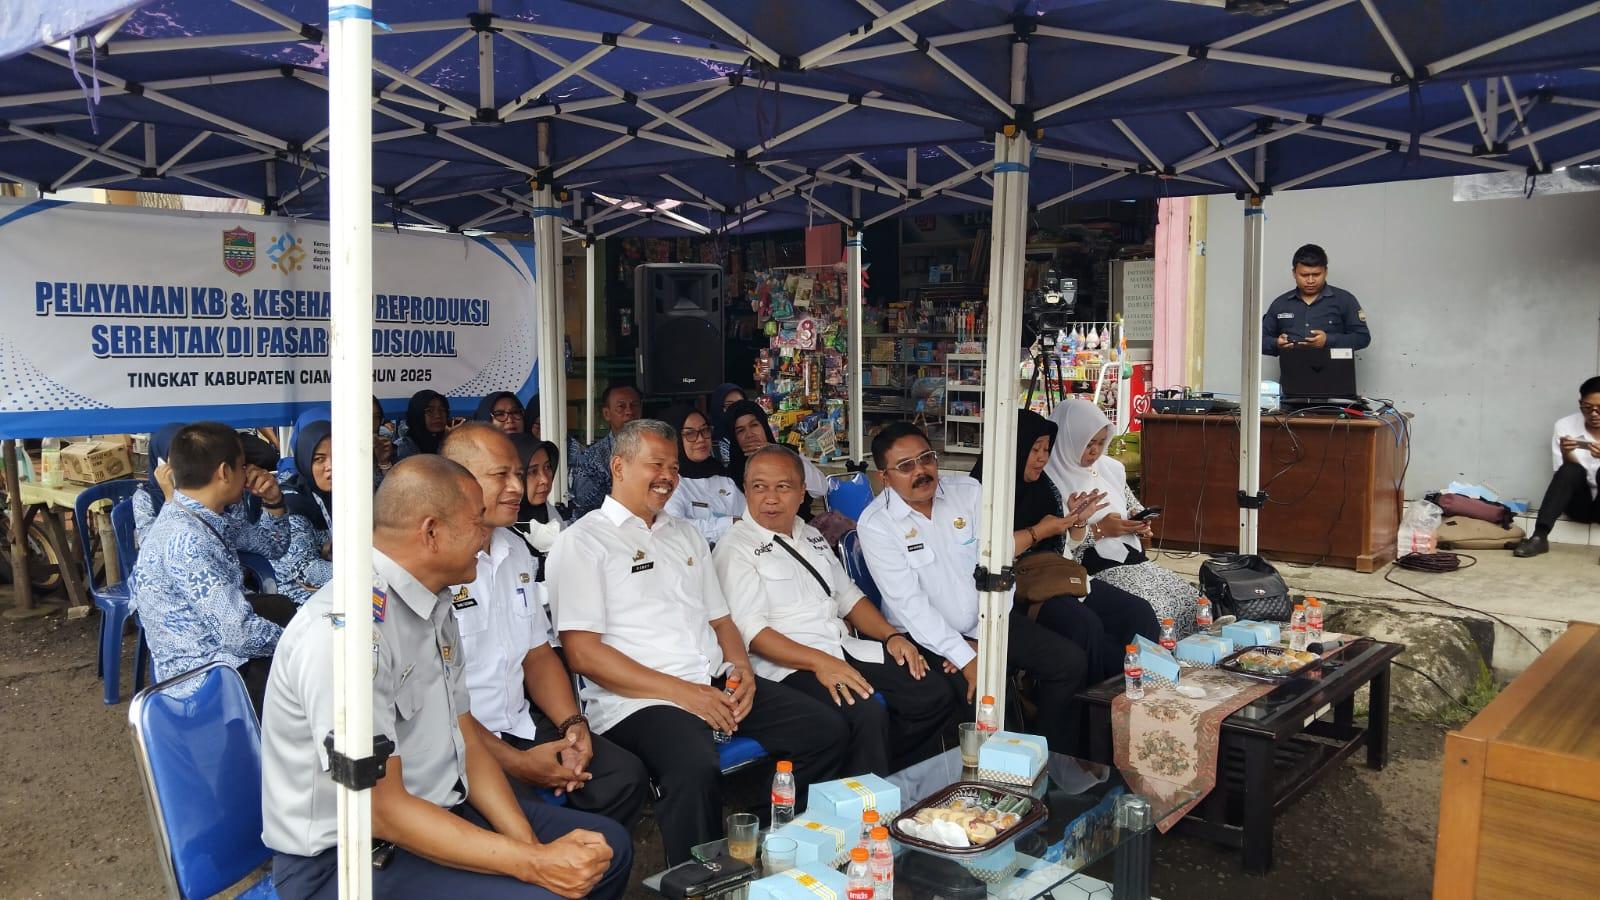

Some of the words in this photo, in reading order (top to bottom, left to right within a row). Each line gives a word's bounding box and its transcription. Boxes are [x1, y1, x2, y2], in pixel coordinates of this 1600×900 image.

[35, 281, 187, 318] PELAYANAN
[190, 287, 227, 320] KB
[230, 291, 251, 319] &
[253, 289, 331, 321] KESEHA
[375, 294, 490, 326] REPRODUKSI
[91, 324, 224, 359] SERENTAK
[226, 326, 254, 358] DI
[256, 327, 330, 359] PASAR
[372, 328, 457, 357] DISIONAL
[127, 372, 199, 389] TINGKAT
[204, 370, 295, 387] KABUPATEN
[400, 369, 432, 382] 2025
